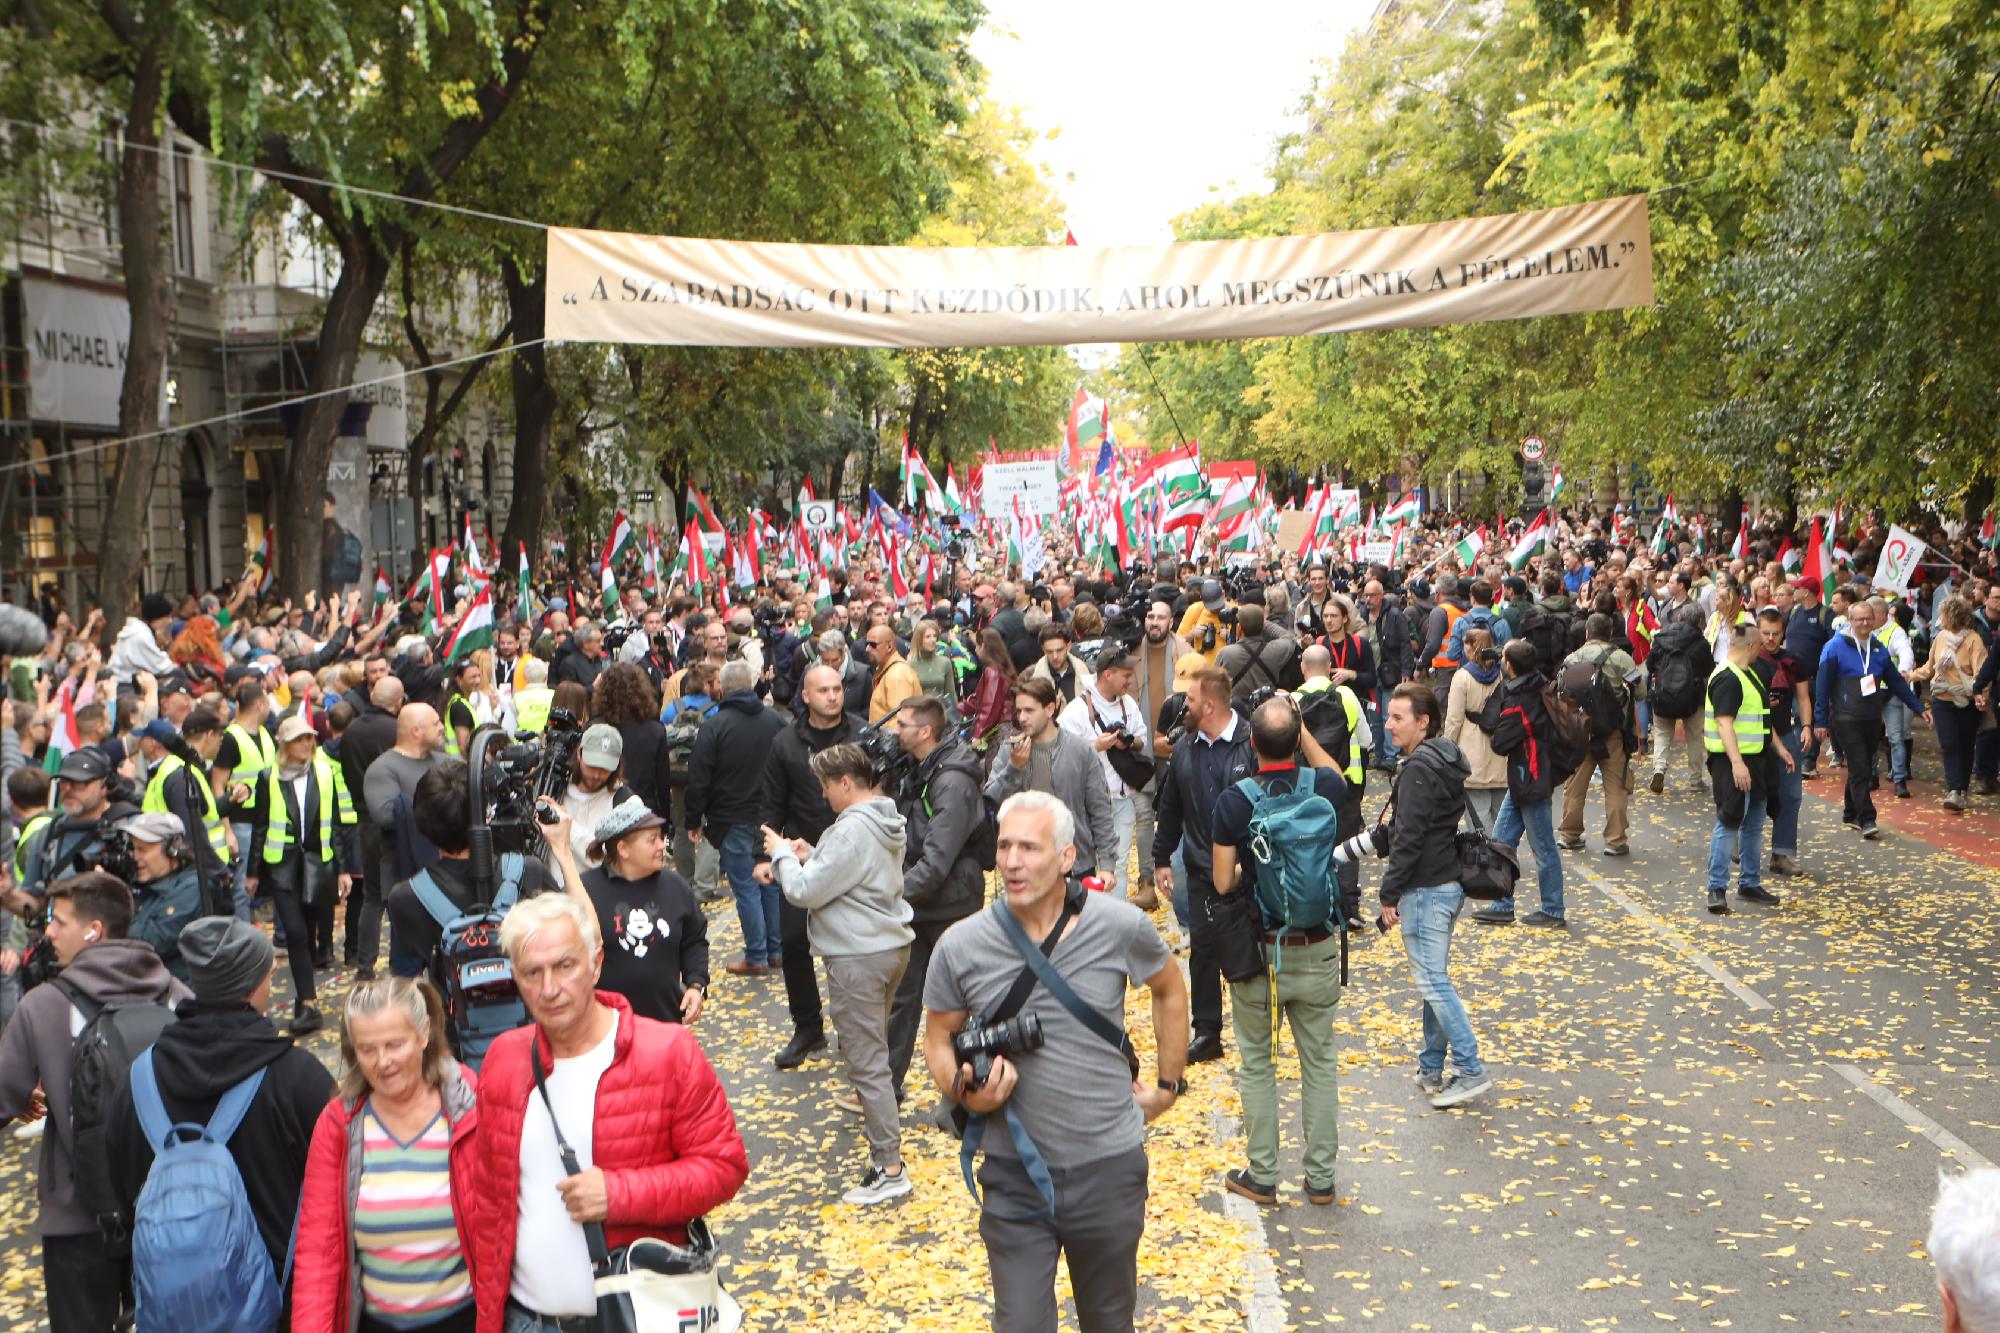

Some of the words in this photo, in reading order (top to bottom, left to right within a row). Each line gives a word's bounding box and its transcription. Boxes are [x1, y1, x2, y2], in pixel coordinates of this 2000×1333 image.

[621, 276, 816, 313] SZABADSÁG
[828, 287, 900, 314] OTT
[910, 283, 1105, 318] KEZDŐDIK,
[1116, 283, 1210, 311] AHOL
[1222, 268, 1418, 307] MEGSZŰNIK
[1429, 265, 1449, 292] A
[34, 328, 114, 369] MICHAEL
